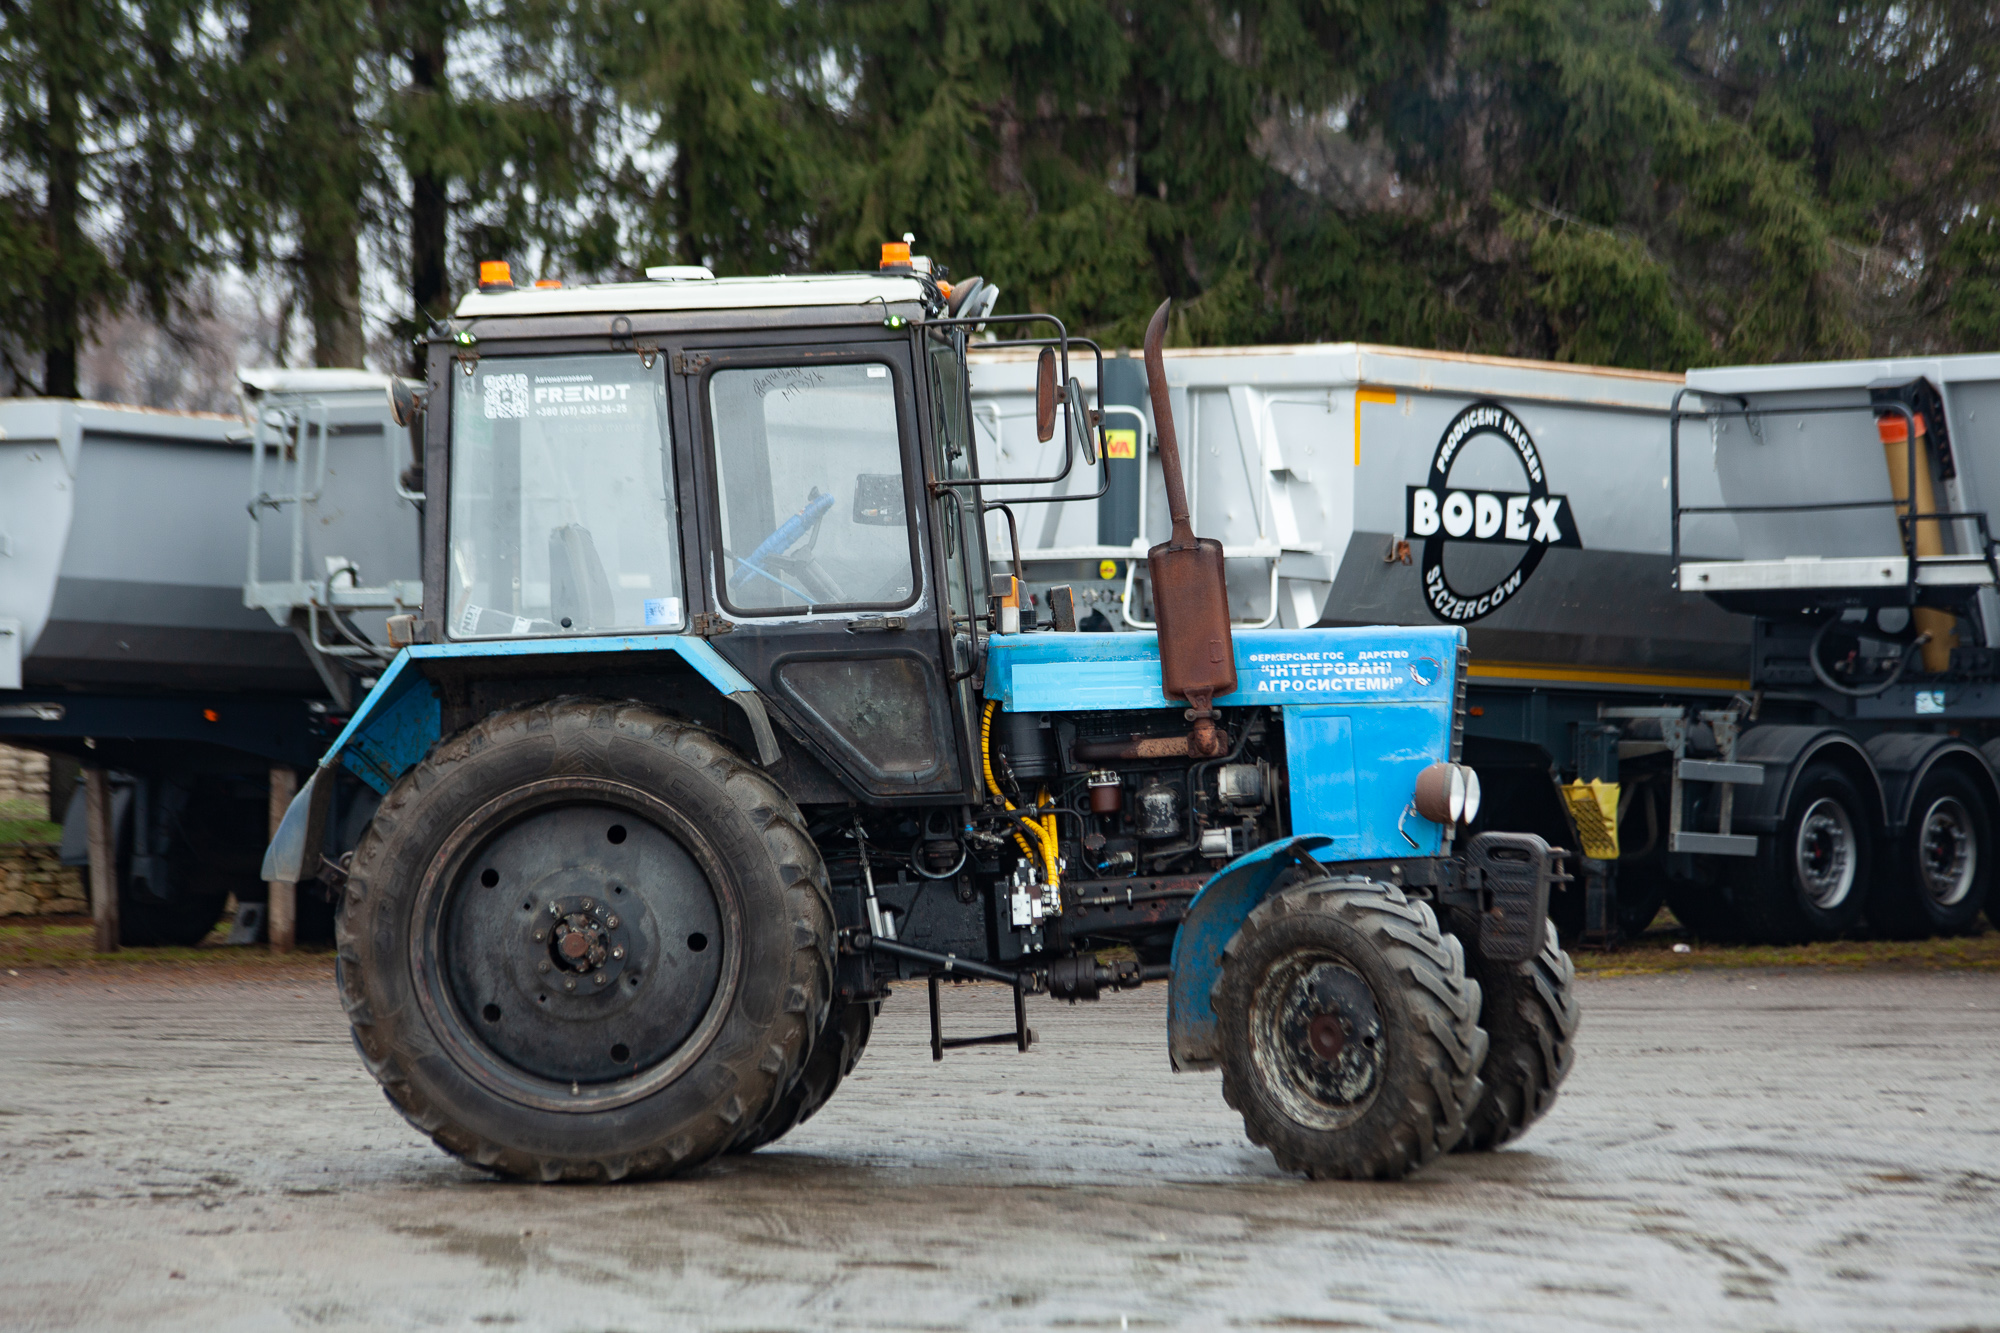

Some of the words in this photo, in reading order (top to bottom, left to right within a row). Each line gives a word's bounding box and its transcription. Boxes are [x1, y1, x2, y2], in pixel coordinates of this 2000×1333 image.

[534, 383, 631, 404] FRENDT
[535, 406, 558, 417] +380
[1436, 407, 1502, 474] PRODUCENT
[1503, 415, 1542, 484] NACZEP
[1413, 488, 1562, 543] BODEX
[1426, 564, 1522, 620] SZCZERCÓW
